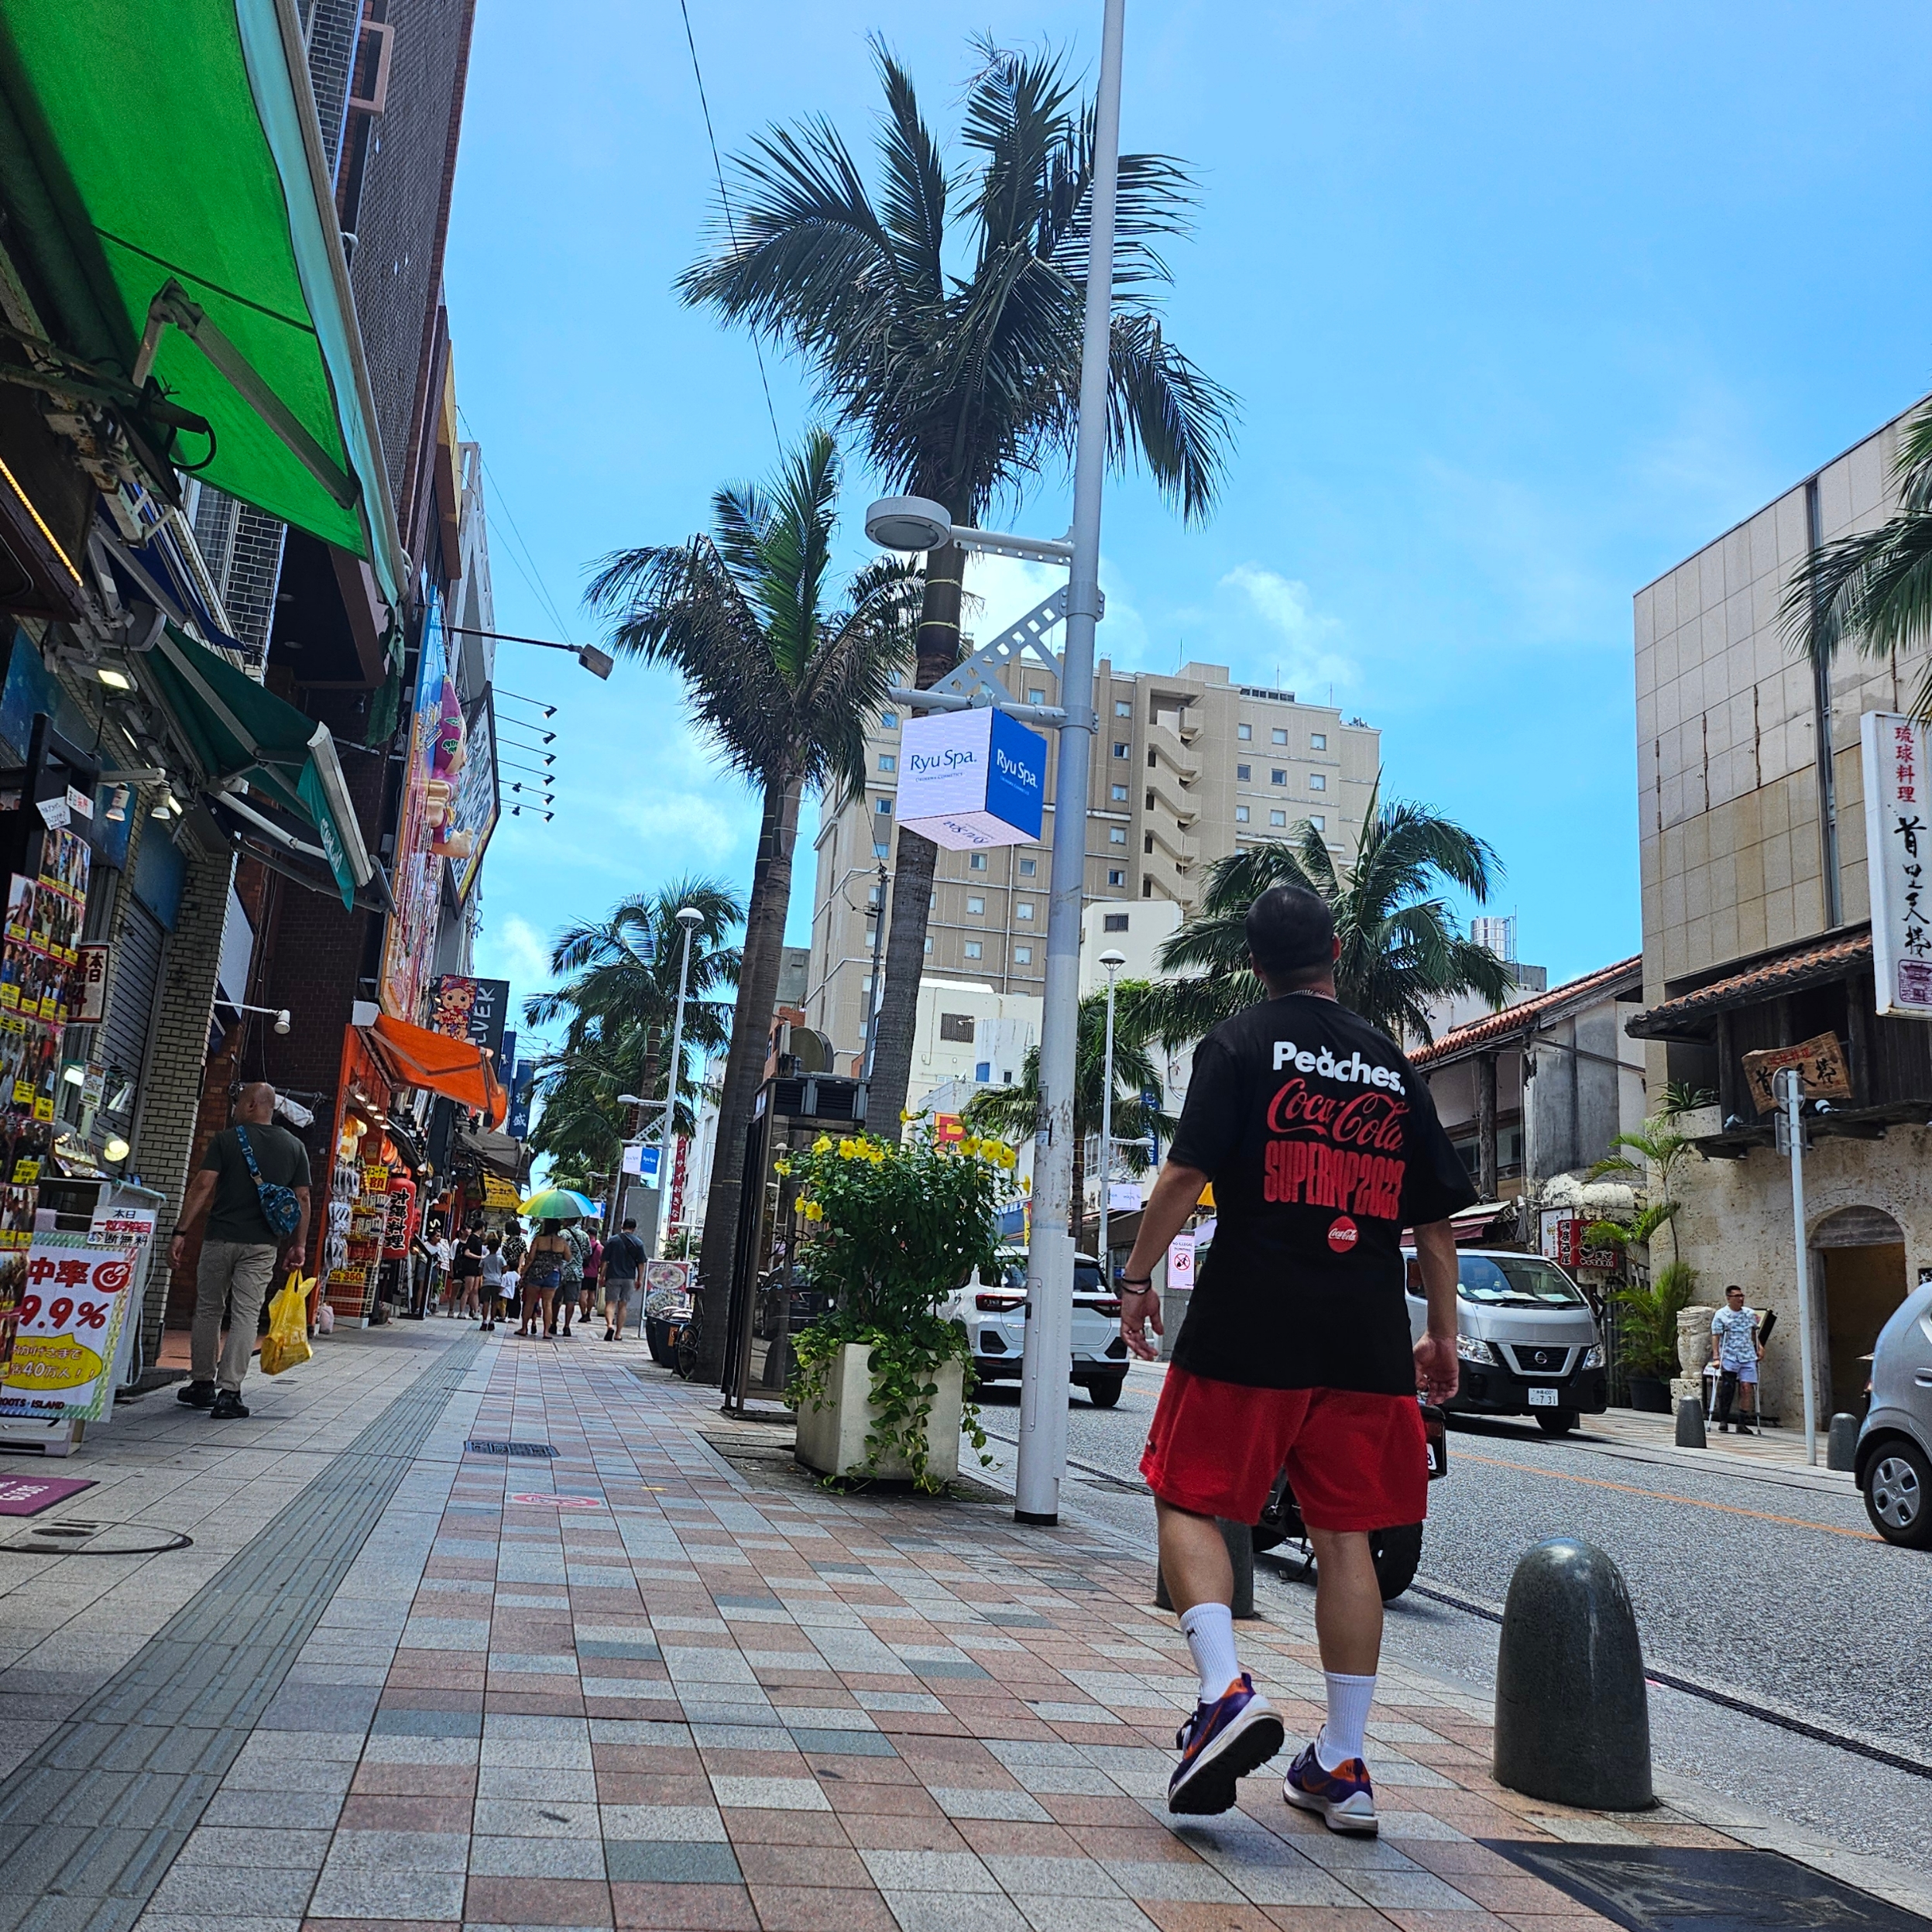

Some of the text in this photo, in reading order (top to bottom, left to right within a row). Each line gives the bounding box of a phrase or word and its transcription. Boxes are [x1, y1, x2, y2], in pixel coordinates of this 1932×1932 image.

[911, 754, 940, 774] Ryu
[997, 748, 1017, 775] Ryu
[1894, 726, 1917, 803] 琉球料理
[88, 951, 105, 983] 本日
[112, 1210, 136, 1219] 本日
[31, 1399, 66, 1410] ISLAND
